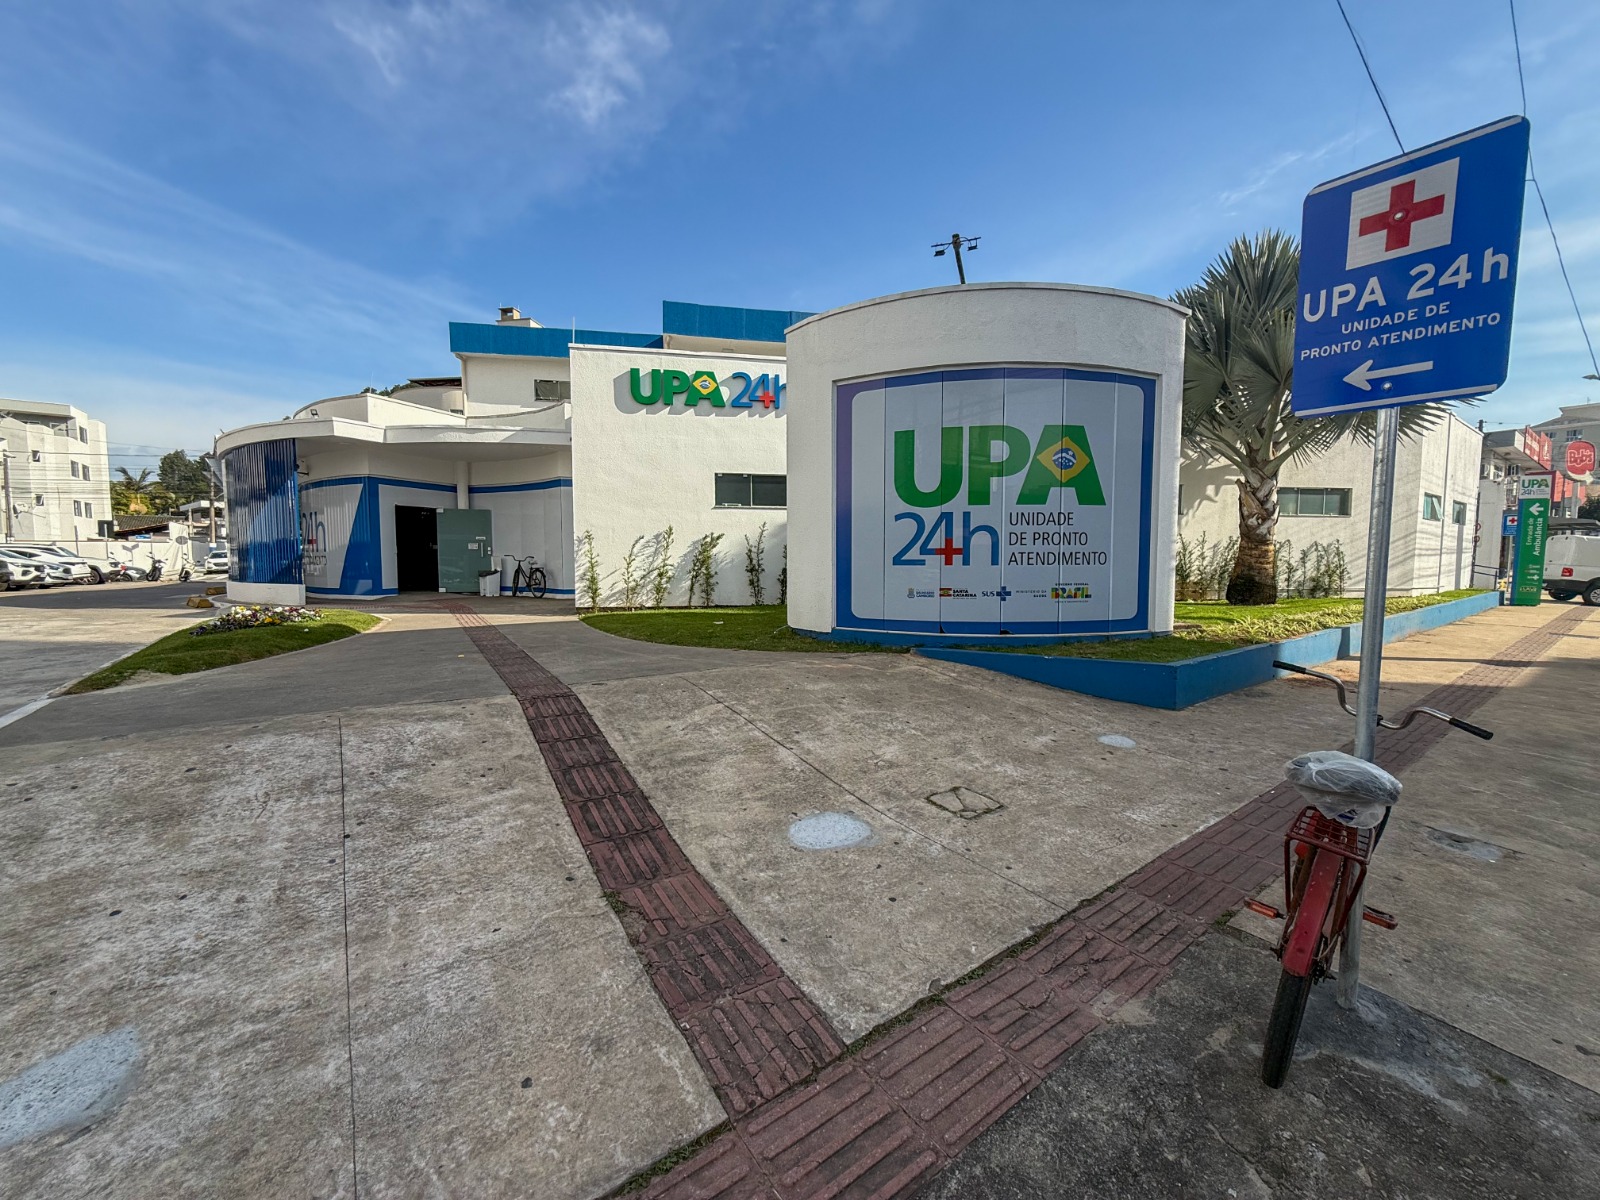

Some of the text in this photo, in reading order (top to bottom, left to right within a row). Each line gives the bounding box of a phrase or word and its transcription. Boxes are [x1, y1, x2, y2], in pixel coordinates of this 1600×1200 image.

[1302, 276, 1387, 323] UPA
[1341, 301, 1451, 335] UNIDADE DE
[1300, 312, 1501, 361] PRONTO ATENDIMENTO
[630, 367, 726, 408] UPA
[893, 424, 1107, 508] UPA
[1521, 478, 1550, 489] UPA
[1521, 488, 1535, 496] 24h
[1009, 511, 1074, 526] UNIDADE
[892, 511, 1000, 566] 24h
[1008, 531, 1088, 546] DE PRONTO
[1525, 525, 1534, 545] Entrada
[1533, 517, 1544, 556] Ambulância
[1007, 551, 1107, 566] ATENDIMENTO
[1051, 586, 1092, 600] BRASIL
